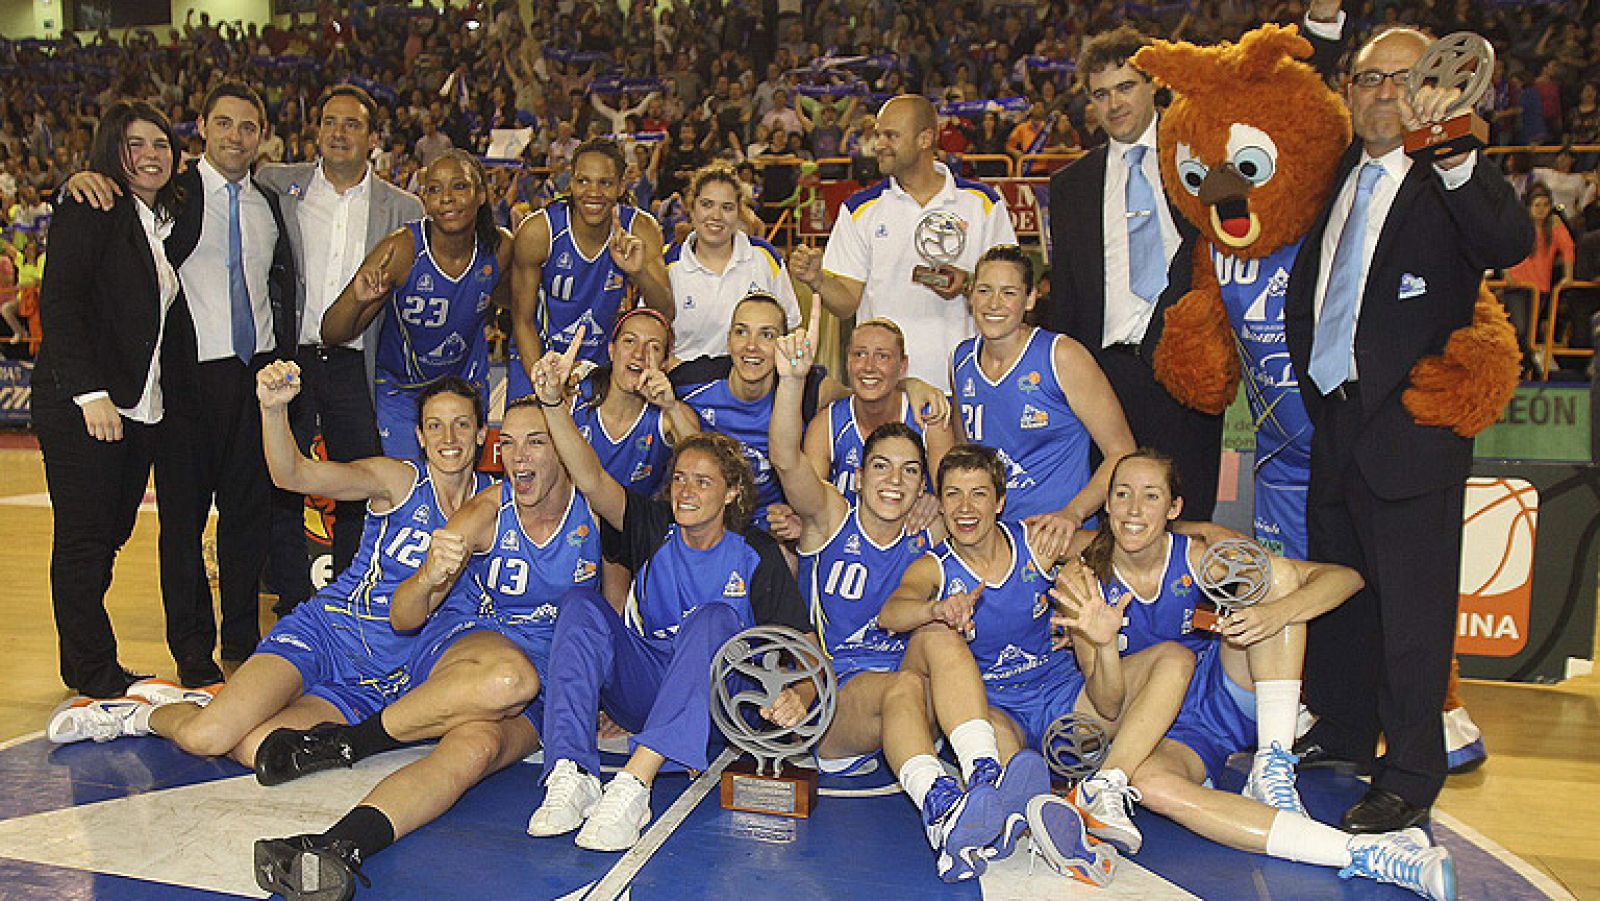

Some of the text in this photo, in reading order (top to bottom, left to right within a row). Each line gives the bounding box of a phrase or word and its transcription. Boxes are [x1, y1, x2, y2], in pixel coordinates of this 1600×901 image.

[551, 274, 574, 301] 11
[402, 295, 449, 328] 23
[961, 404, 984, 441] 21
[1495, 387, 1577, 425] EÓN
[385, 527, 432, 569] 12
[487, 556, 530, 596] 13
[824, 560, 868, 601] 10
[1459, 612, 1520, 640] INA
